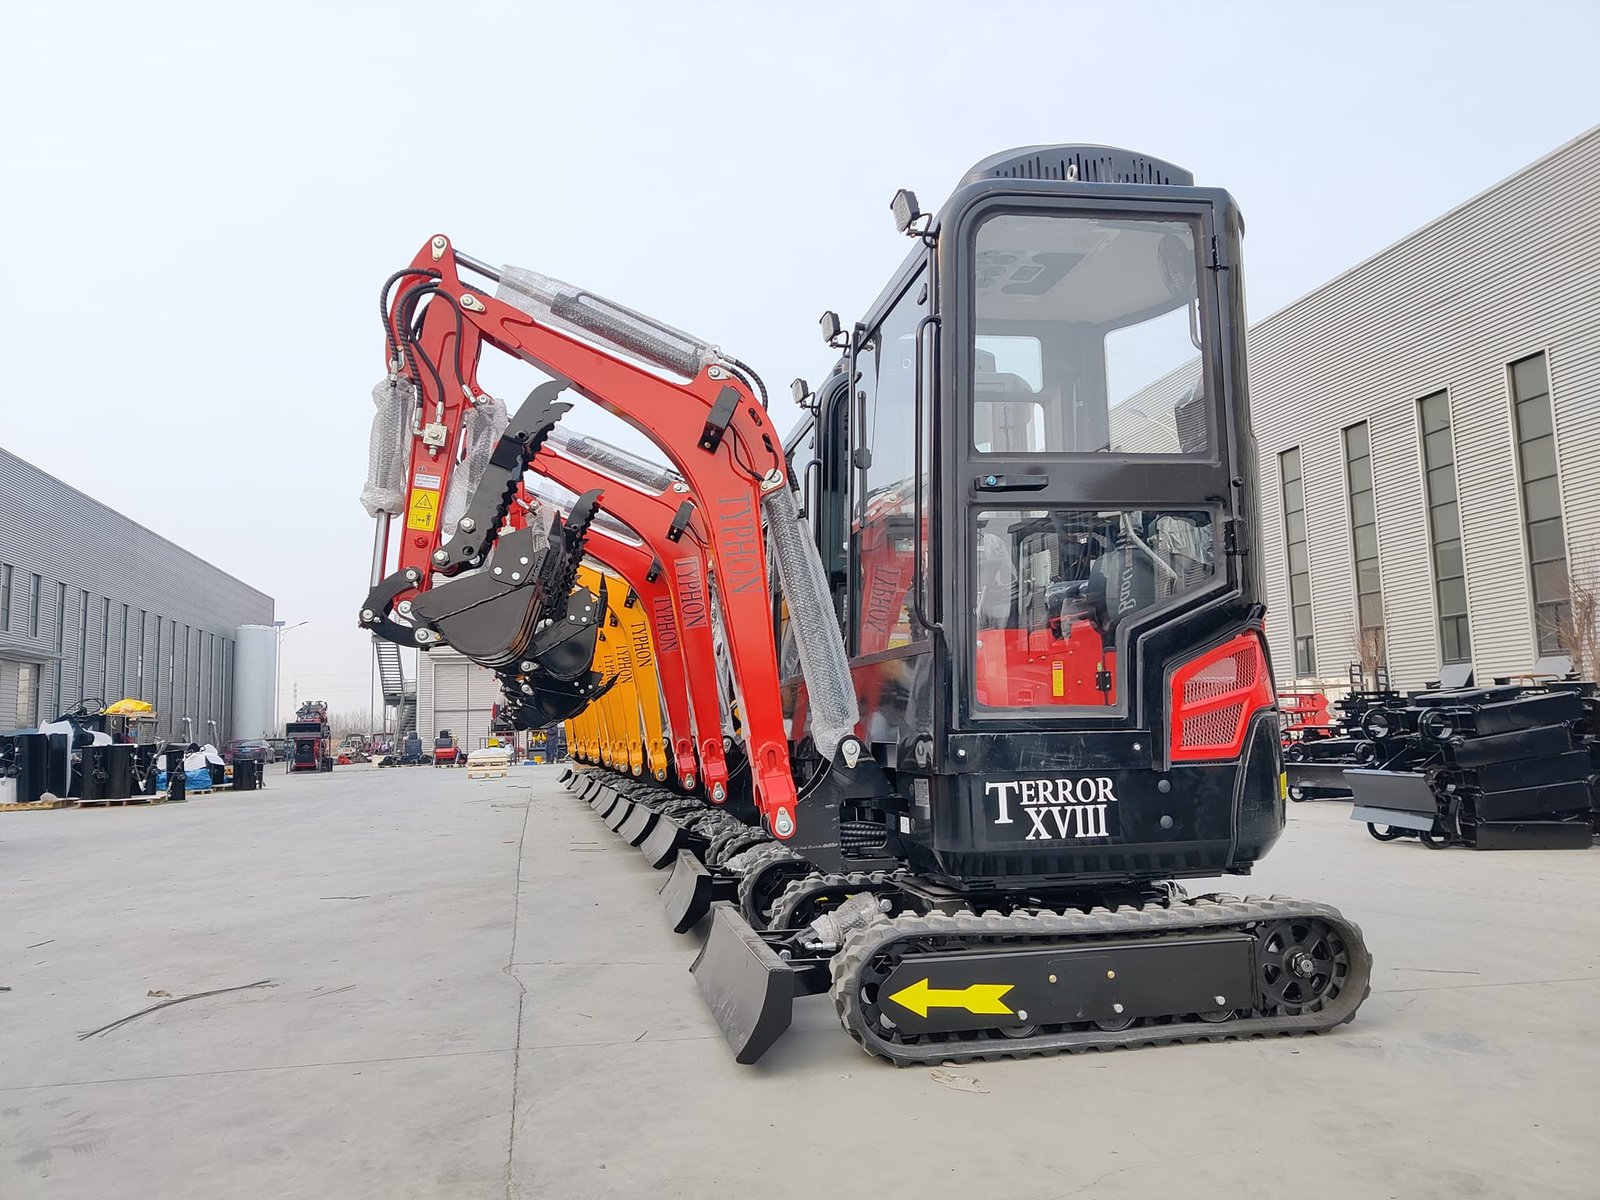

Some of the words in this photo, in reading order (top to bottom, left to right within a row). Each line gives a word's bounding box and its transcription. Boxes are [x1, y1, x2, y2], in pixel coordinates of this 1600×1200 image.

[719, 492, 762, 593] TYPHON
[676, 560, 706, 628] TYPHON
[631, 621, 653, 667] TYPHON
[654, 597, 678, 653] TYPHON
[616, 645, 633, 683] TYPHON
[985, 777, 1117, 824] TERROR
[1024, 804, 1110, 840] XVIII
